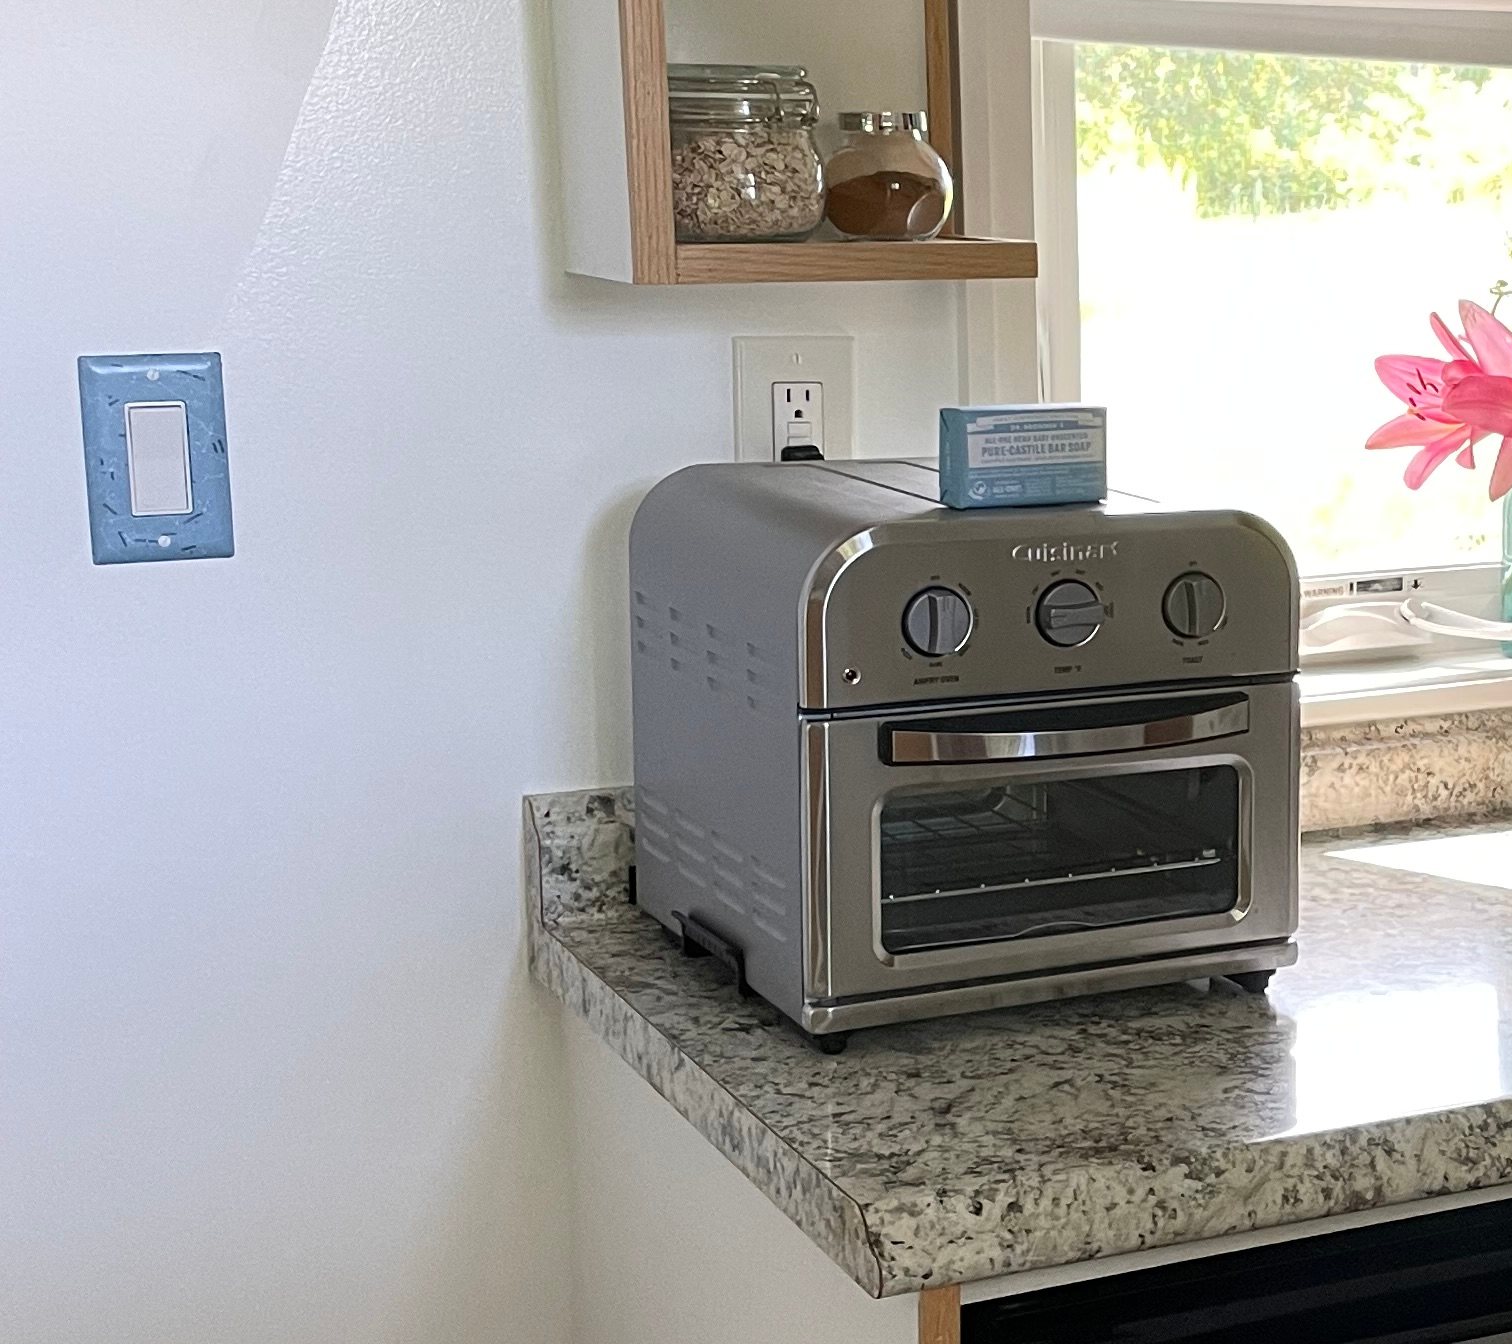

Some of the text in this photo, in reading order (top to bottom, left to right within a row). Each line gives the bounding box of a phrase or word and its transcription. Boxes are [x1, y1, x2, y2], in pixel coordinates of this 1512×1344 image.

[981, 442, 1092, 457] PURE-CASTILE BAR SOAP
